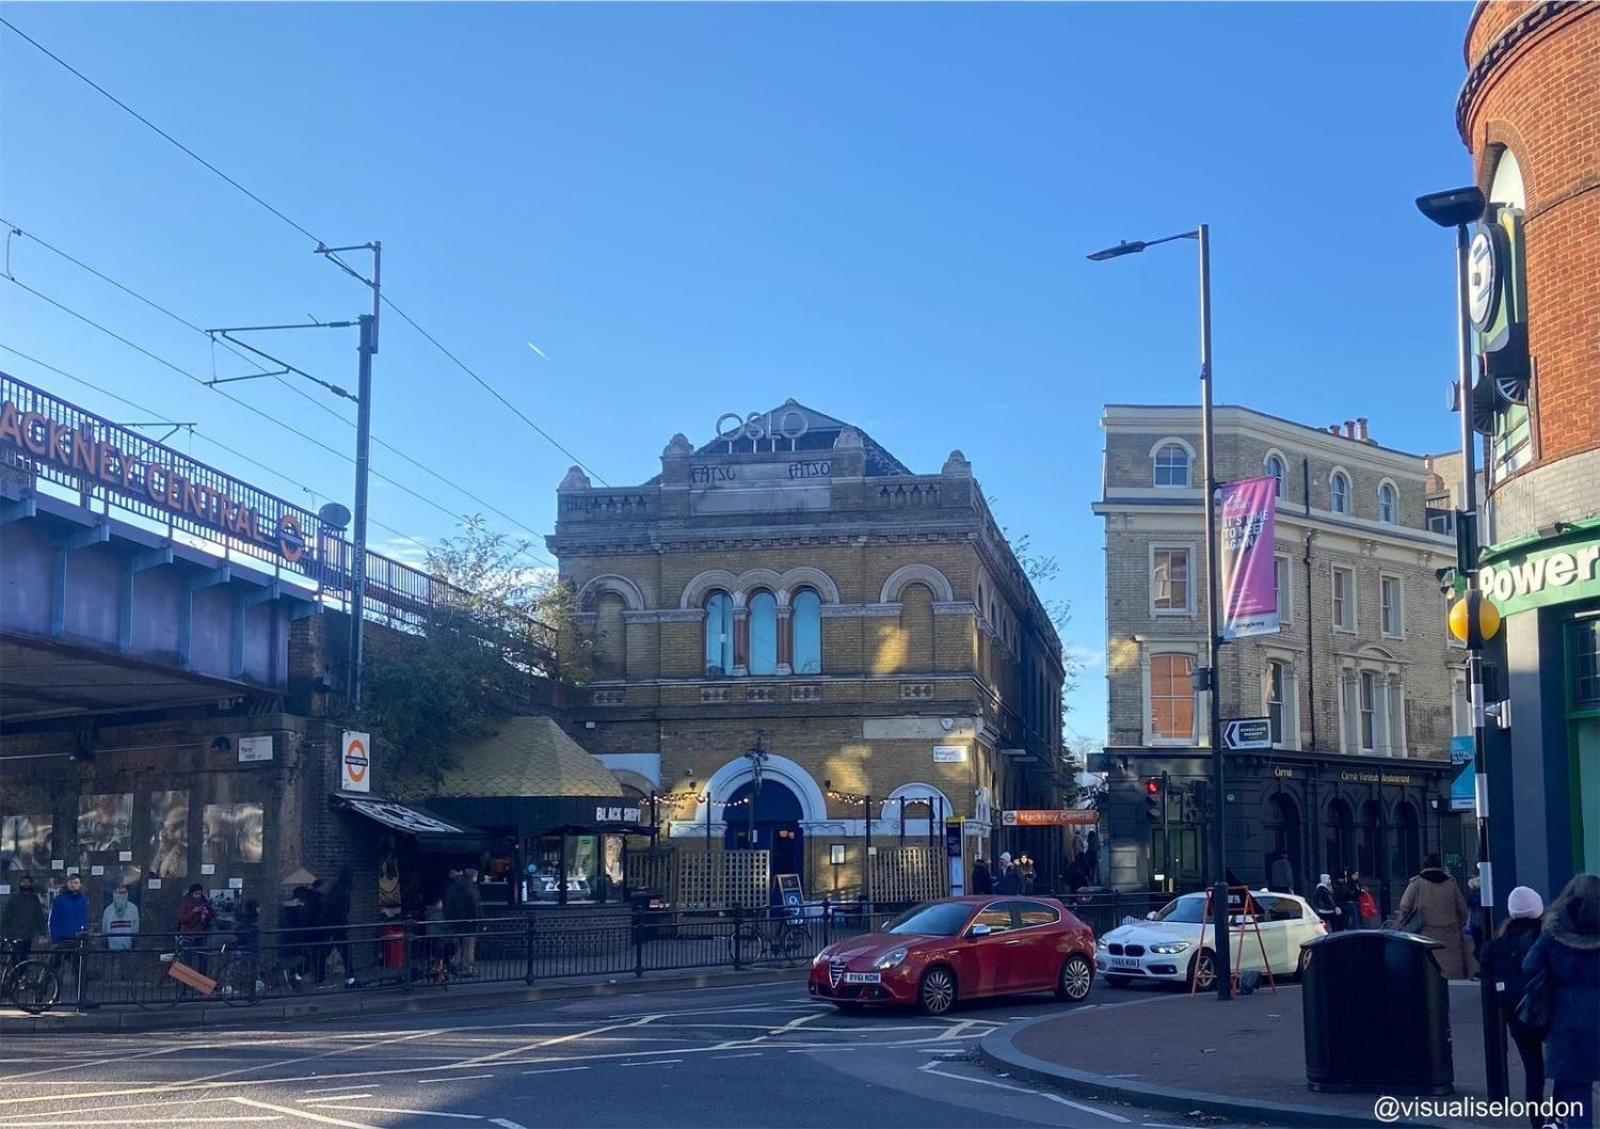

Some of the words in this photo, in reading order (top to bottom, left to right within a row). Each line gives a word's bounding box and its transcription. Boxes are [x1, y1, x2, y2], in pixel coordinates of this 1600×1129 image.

[716, 412, 808, 441] OSLO
[145, 461, 265, 542] CENTRAL
[1224, 515, 1242, 528] IT'S
[1224, 527, 1236, 539] TO
[1480, 545, 1599, 602] Power
[596, 806, 622, 821] BLACK
[1020, 812, 1058, 823] Hackney
[1060, 812, 1093, 821] Central
